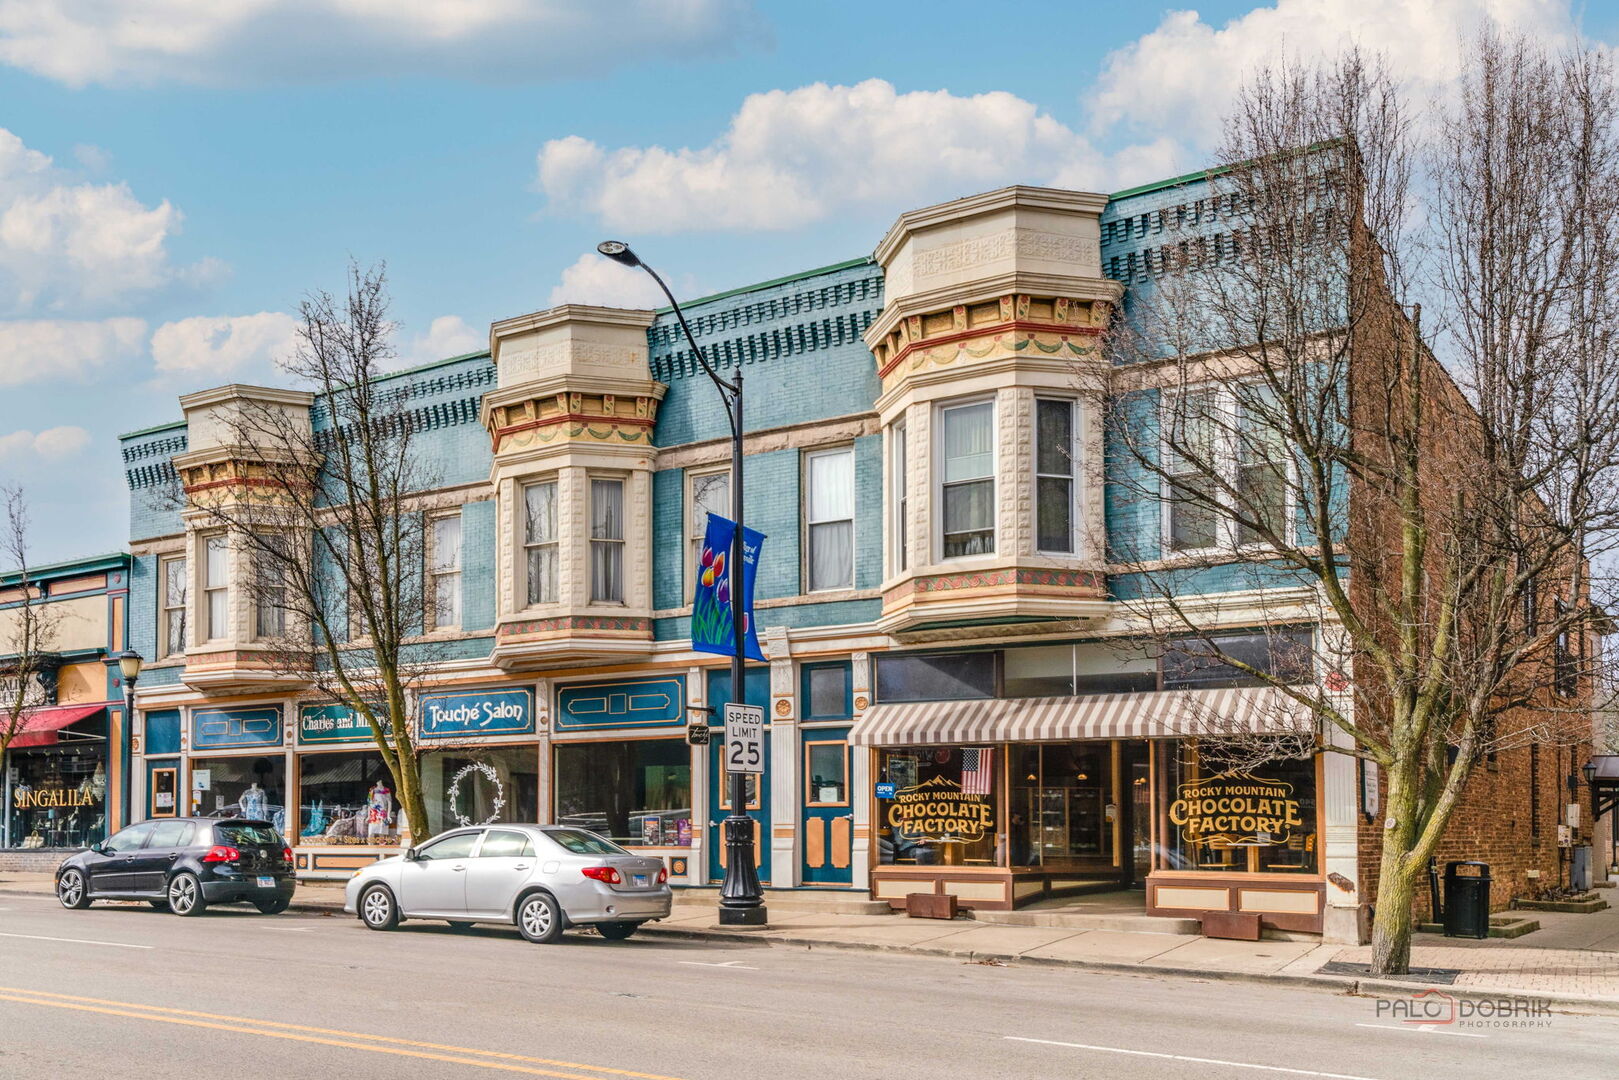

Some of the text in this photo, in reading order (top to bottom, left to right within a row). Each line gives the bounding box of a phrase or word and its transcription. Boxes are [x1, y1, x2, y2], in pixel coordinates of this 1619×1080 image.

[302, 714, 335, 731] Charles
[336, 713, 354, 729] and
[429, 701, 523, 729] Touché Salon
[729, 712, 760, 725] SPEED
[732, 727, 757, 738] LIMIT
[730, 740, 760, 765] 25
[14, 786, 94, 808] SINGALILA
[899, 791, 981, 804] ROCKY MOUNTAIN
[1183, 785, 1286, 799] ROCKY MOUNTAIN
[888, 802, 994, 828] CHOCOLATE
[1168, 797, 1303, 827] CHOCOLATE
[903, 818, 980, 835] FACTORY
[1188, 815, 1285, 834] FACTORY
